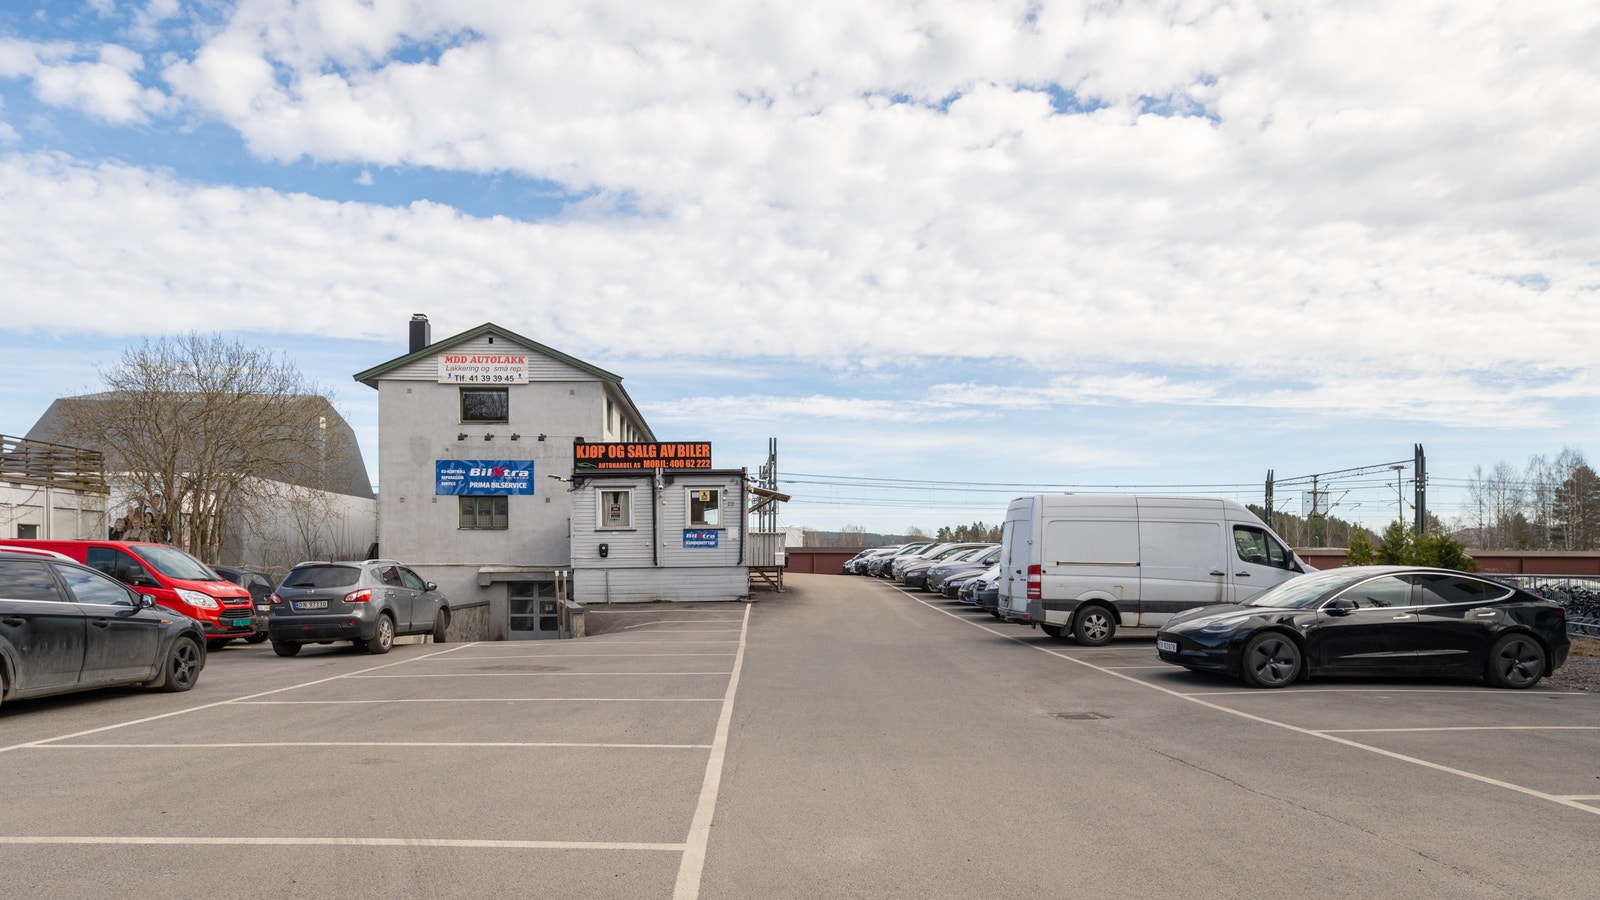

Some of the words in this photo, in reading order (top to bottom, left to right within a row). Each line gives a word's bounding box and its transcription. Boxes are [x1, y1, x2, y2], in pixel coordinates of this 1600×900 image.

[445, 355, 467, 364] MDD
[470, 355, 525, 364] AUTOLAKK
[445, 365, 479, 373] Lakkering
[454, 374, 467, 382] Tlf.
[576, 445, 606, 459] KJØP
[608, 445, 625, 459] OG
[627, 444, 656, 458] SALG
[660, 444, 676, 458] AV
[677, 444, 710, 458] BILER
[643, 460, 669, 468] MOBIL:
[669, 460, 684, 468] 400
[685, 460, 695, 468] 62
[696, 460, 710, 468] 222
[469, 466, 529, 478] BilXtra
[469, 481, 490, 489] PRIMA
[491, 481, 527, 489] BILSERVICE
